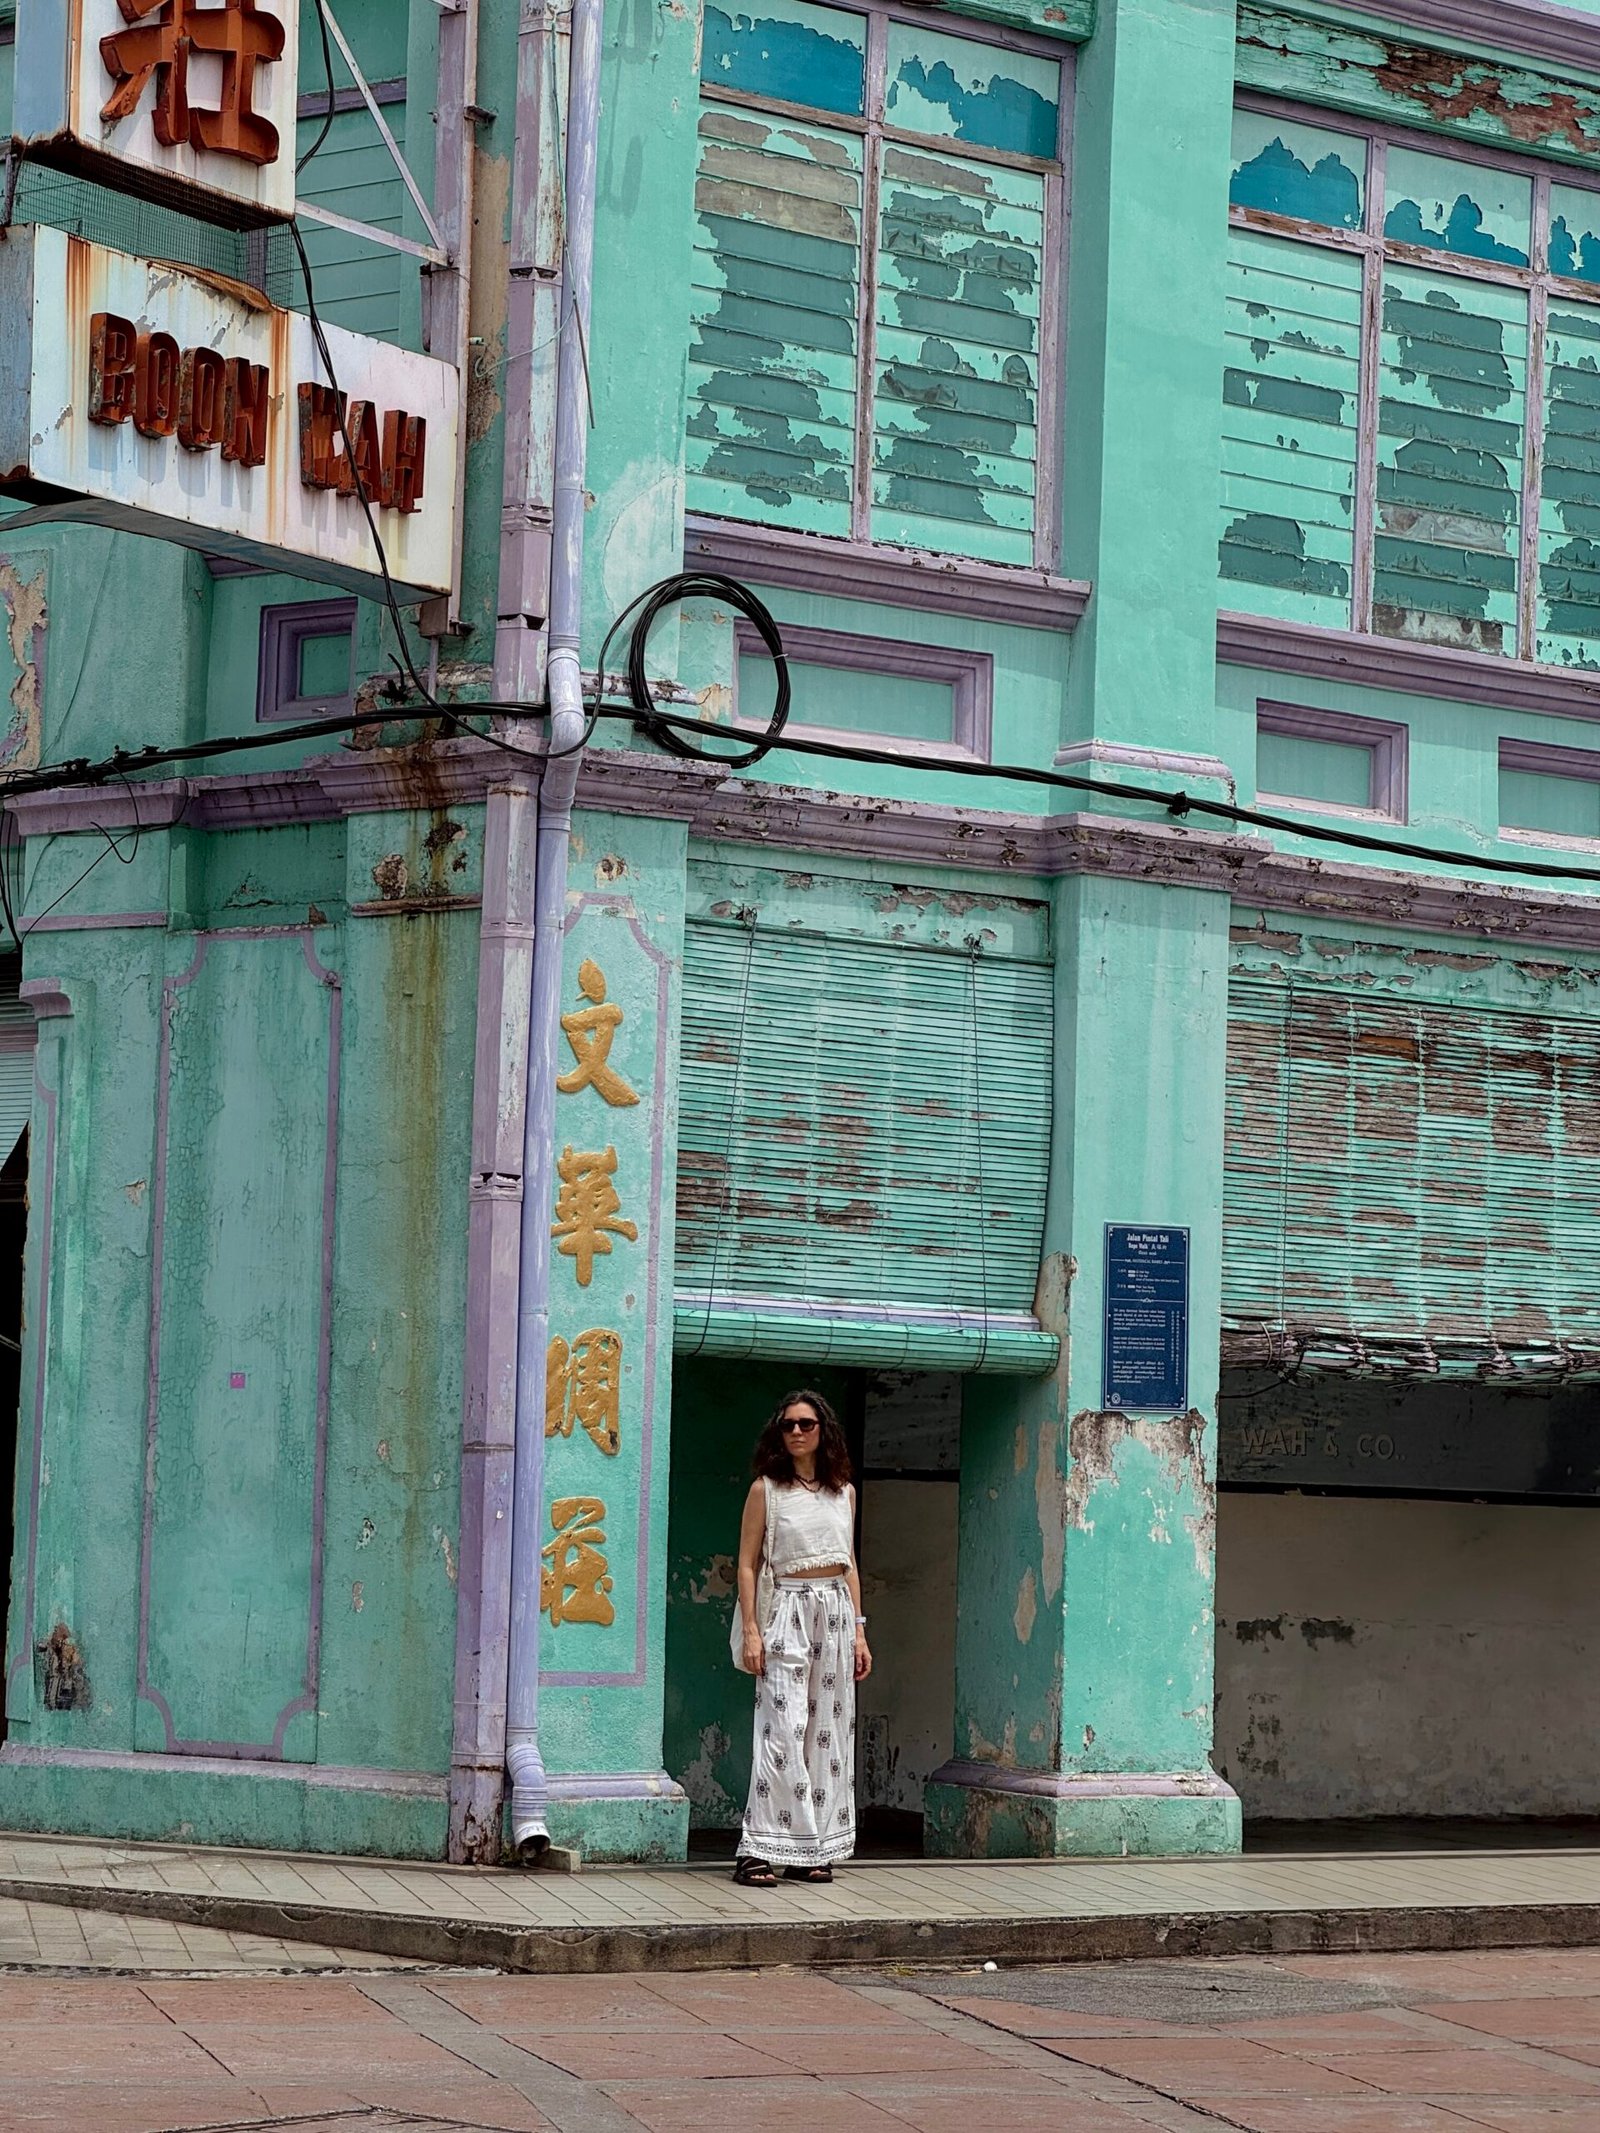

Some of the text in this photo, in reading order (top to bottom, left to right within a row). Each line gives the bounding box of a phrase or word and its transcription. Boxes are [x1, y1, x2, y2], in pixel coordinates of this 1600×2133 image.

[88, 312, 270, 469] BOON
[1126, 1233, 1141, 1241] Jalan
[1241, 1425, 1308, 1457] WAH
[1323, 1432, 1340, 1459] &
